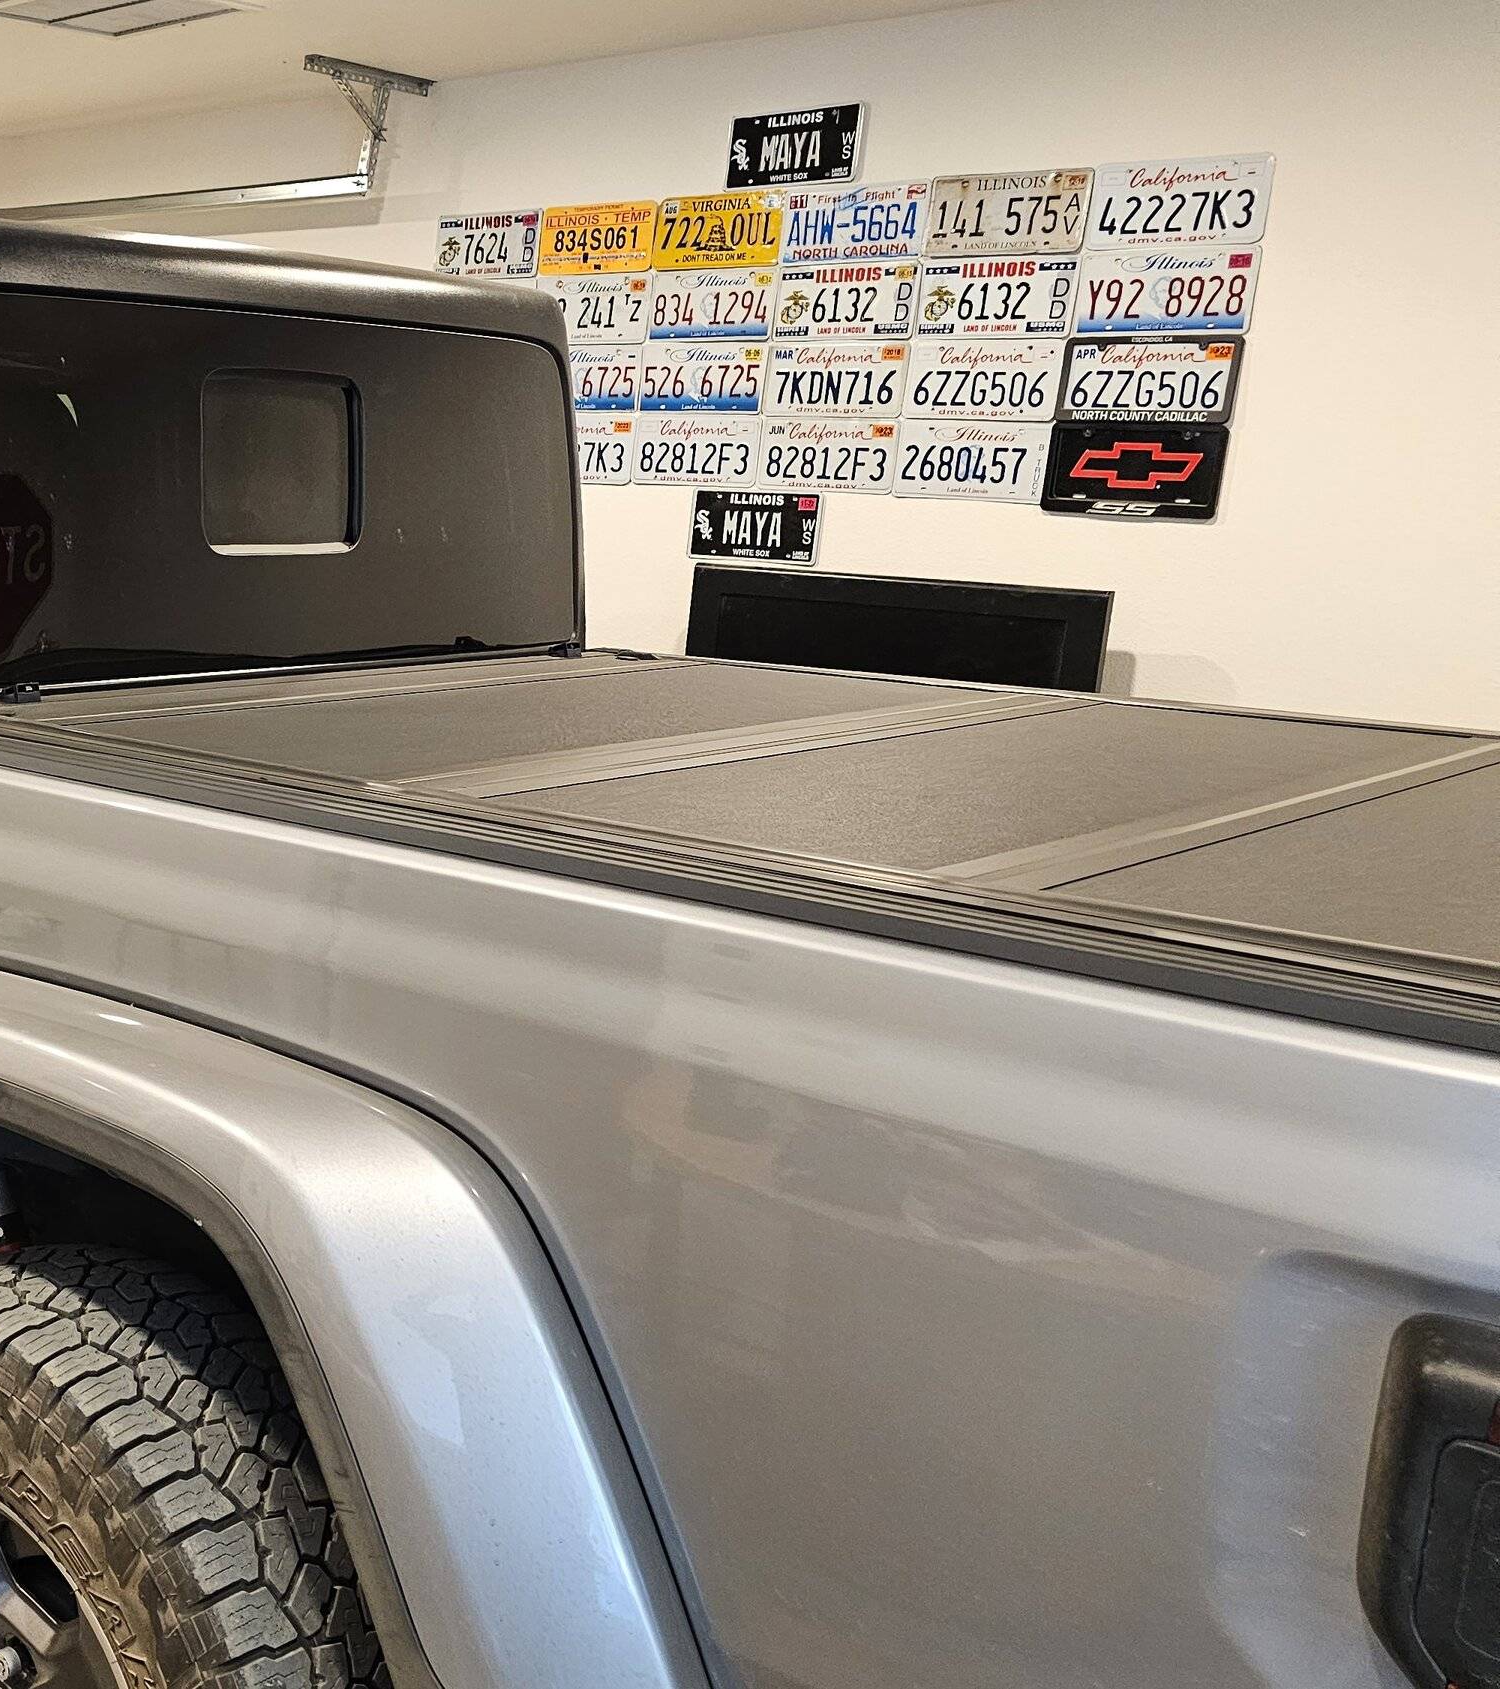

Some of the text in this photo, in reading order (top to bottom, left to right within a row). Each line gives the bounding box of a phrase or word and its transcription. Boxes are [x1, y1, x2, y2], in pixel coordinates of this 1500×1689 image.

[767, 111, 824, 128] ILLINOIS
[758, 130, 821, 172] MAYA
[769, 172, 809, 182] WHITE SOX
[977, 175, 1047, 191] ILLINOIS
[1129, 167, 1238, 193] California
[692, 197, 751, 212] VIRGINIA
[817, 195, 841, 205] First
[864, 190, 895, 202] Flight
[546, 214, 600, 228] ILLINOIS
[613, 210, 651, 223] TEMP
[665, 205, 678, 214] AUG
[932, 194, 1062, 239] 141 575
[1099, 189, 1256, 235] 42227K3
[464, 215, 513, 230] ILLINOIS
[660, 215, 706, 250] 722
[787, 201, 918, 247] AHW-5664
[464, 231, 508, 265] 7624
[554, 224, 638, 252] 834S061
[1127, 234, 1217, 244] dmv.ca.gov
[702, 252, 723, 262] TREAD
[724, 252, 735, 261] ON
[736, 252, 747, 260] ME
[793, 242, 908, 260] NORTH CAROLINA
[962, 261, 1036, 278] ILLINOIS
[1121, 253, 1215, 272] Illinois
[680, 273, 748, 290] Illinois
[815, 266, 882, 284] ILLINOIS
[563, 280, 623, 295] Illinois
[1089, 274, 1247, 321] Y92 8928
[654, 289, 767, 326] 834 1294
[811, 286, 878, 323] 6132
[958, 281, 1031, 320] 6132
[577, 296, 615, 329] 241
[817, 327, 831, 335] LAND
[842, 326, 866, 334] LINCOLN
[963, 324, 1017, 333] LAND OF LINCOLN
[670, 347, 738, 363] Illinois
[775, 350, 793, 360] MAR
[797, 347, 881, 369] California
[941, 346, 1033, 369] California
[1076, 349, 1098, 360] APR
[1101, 345, 1206, 369] California
[582, 366, 636, 398] 6725
[644, 364, 760, 398] 526 6725
[776, 370, 897, 405] 7KDN716
[913, 371, 1048, 407] 6ZZG506
[1071, 370, 1224, 409] 6ZZG506
[1072, 410, 1207, 422] NORTH COUNTY CADILLAC
[661, 420, 736, 440] California
[769, 426, 785, 435] JUN
[790, 423, 872, 444] California
[935, 426, 1017, 442] Illinois
[578, 442, 624, 472] 7K3
[640, 442, 749, 475] 82812F3
[766, 446, 887, 481] 82812F3
[901, 444, 1027, 485] 2680457
[788, 481, 857, 489] dmv.ca.gov
[730, 493, 784, 505] ILLINOIS
[722, 510, 781, 548] MAYA
[732, 548, 770, 557] WHITE SOX
